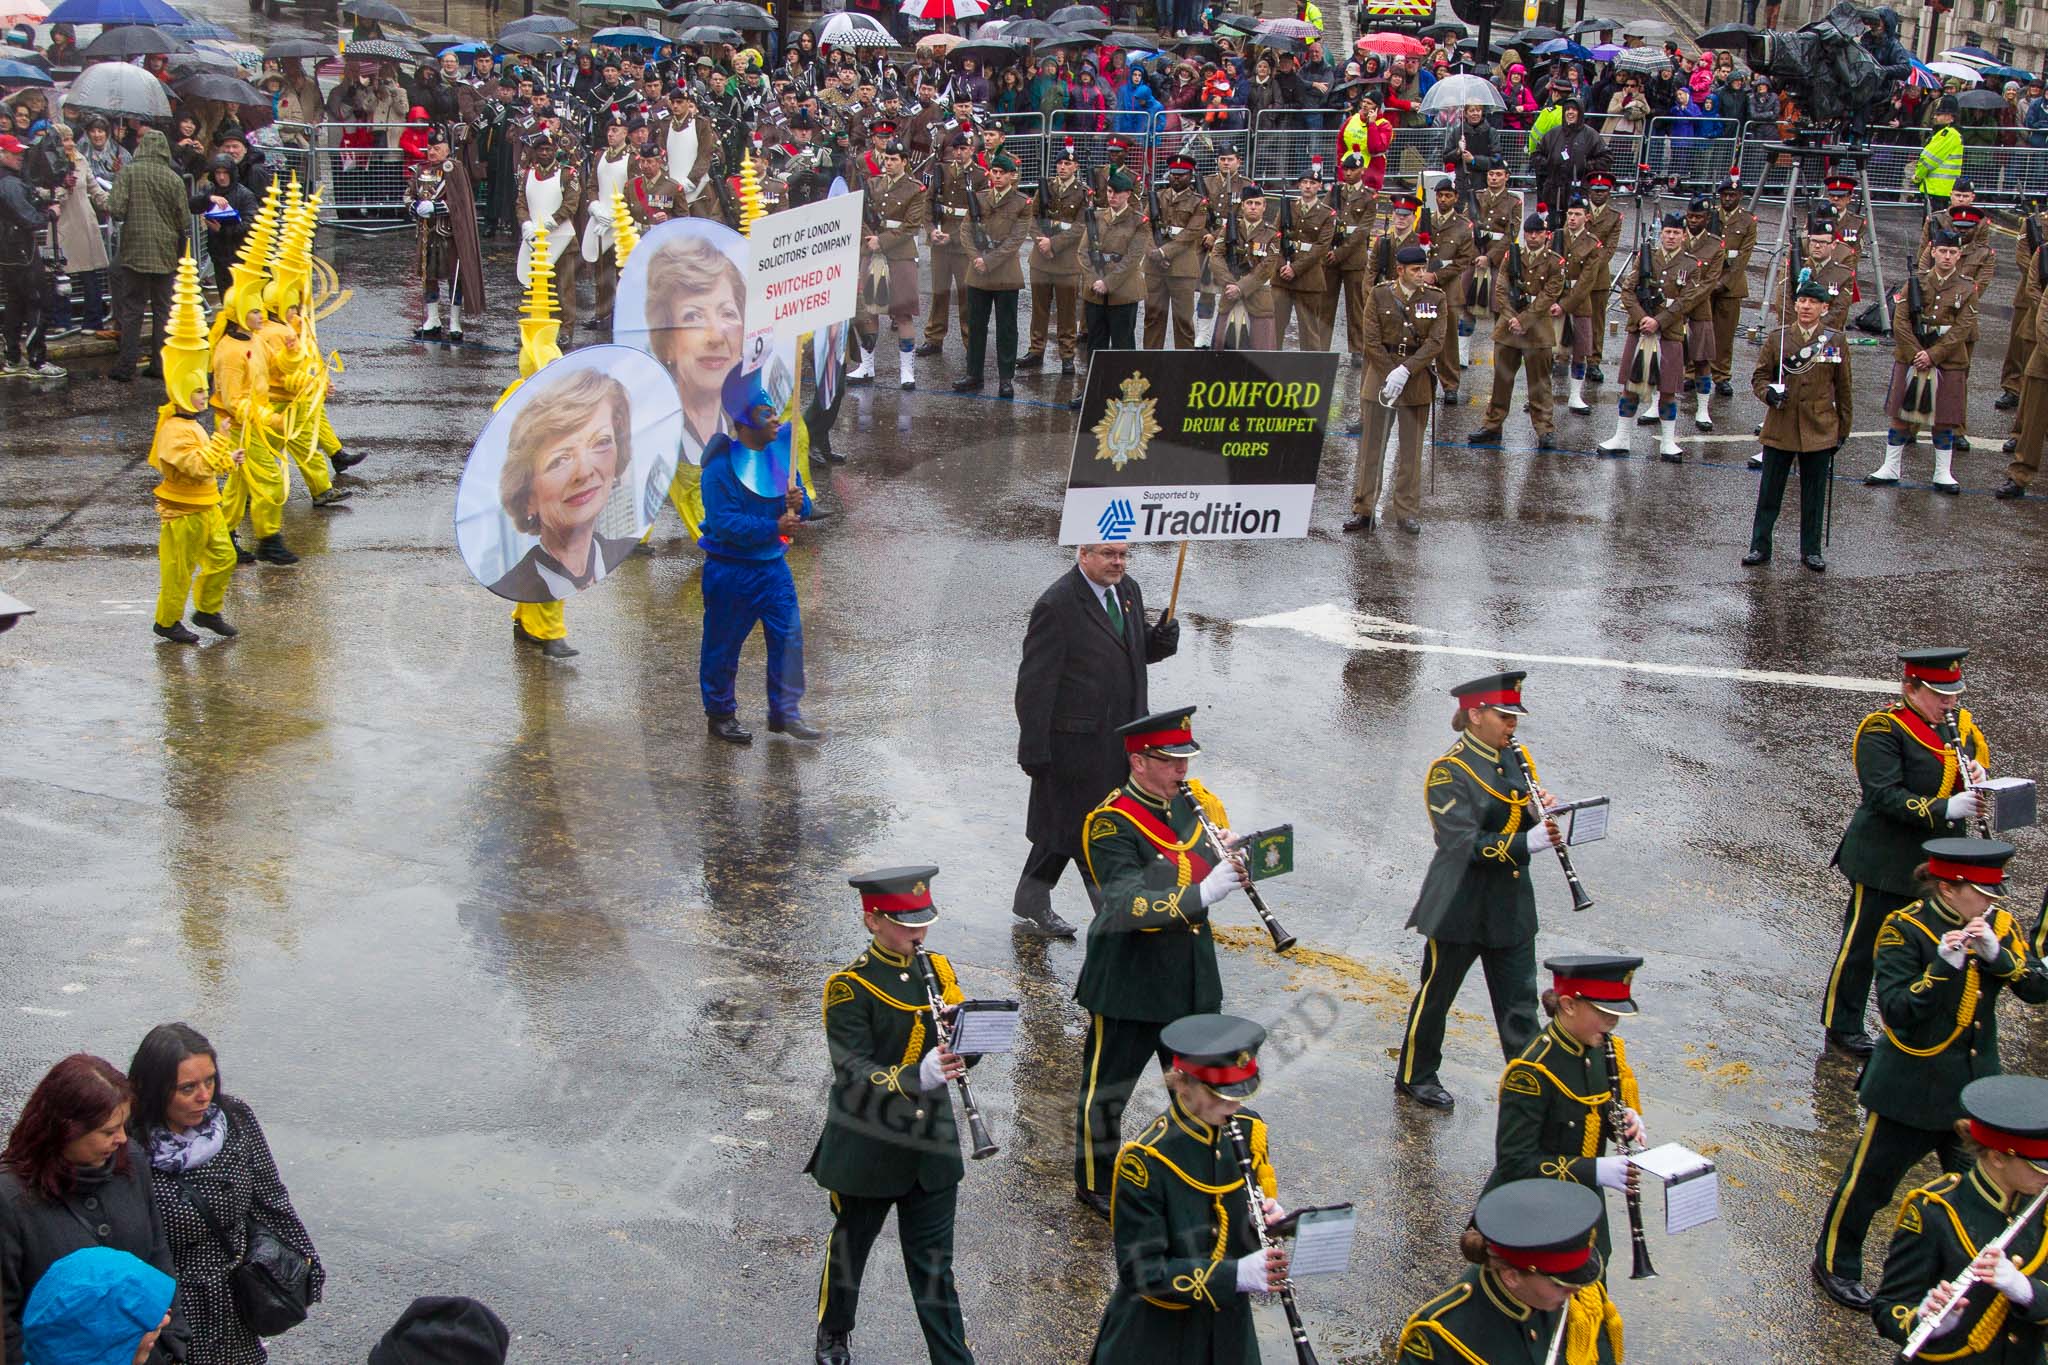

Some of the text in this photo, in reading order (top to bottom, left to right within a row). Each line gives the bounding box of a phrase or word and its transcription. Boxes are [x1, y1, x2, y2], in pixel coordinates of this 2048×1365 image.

[772, 219, 841, 248] CITY OF LONDON
[811, 233, 853, 256] COMPANY
[766, 263, 842, 300] SWITCHED ON
[774, 289, 831, 321] LAWYERS!
[1187, 381, 1321, 409] ROMFORD
[1182, 417, 1317, 433] DRUM & TRUMPET
[1222, 442, 1269, 457] CORPS
[1143, 489, 1200, 502] Supported by
[1140, 502, 1281, 536] Tradition
